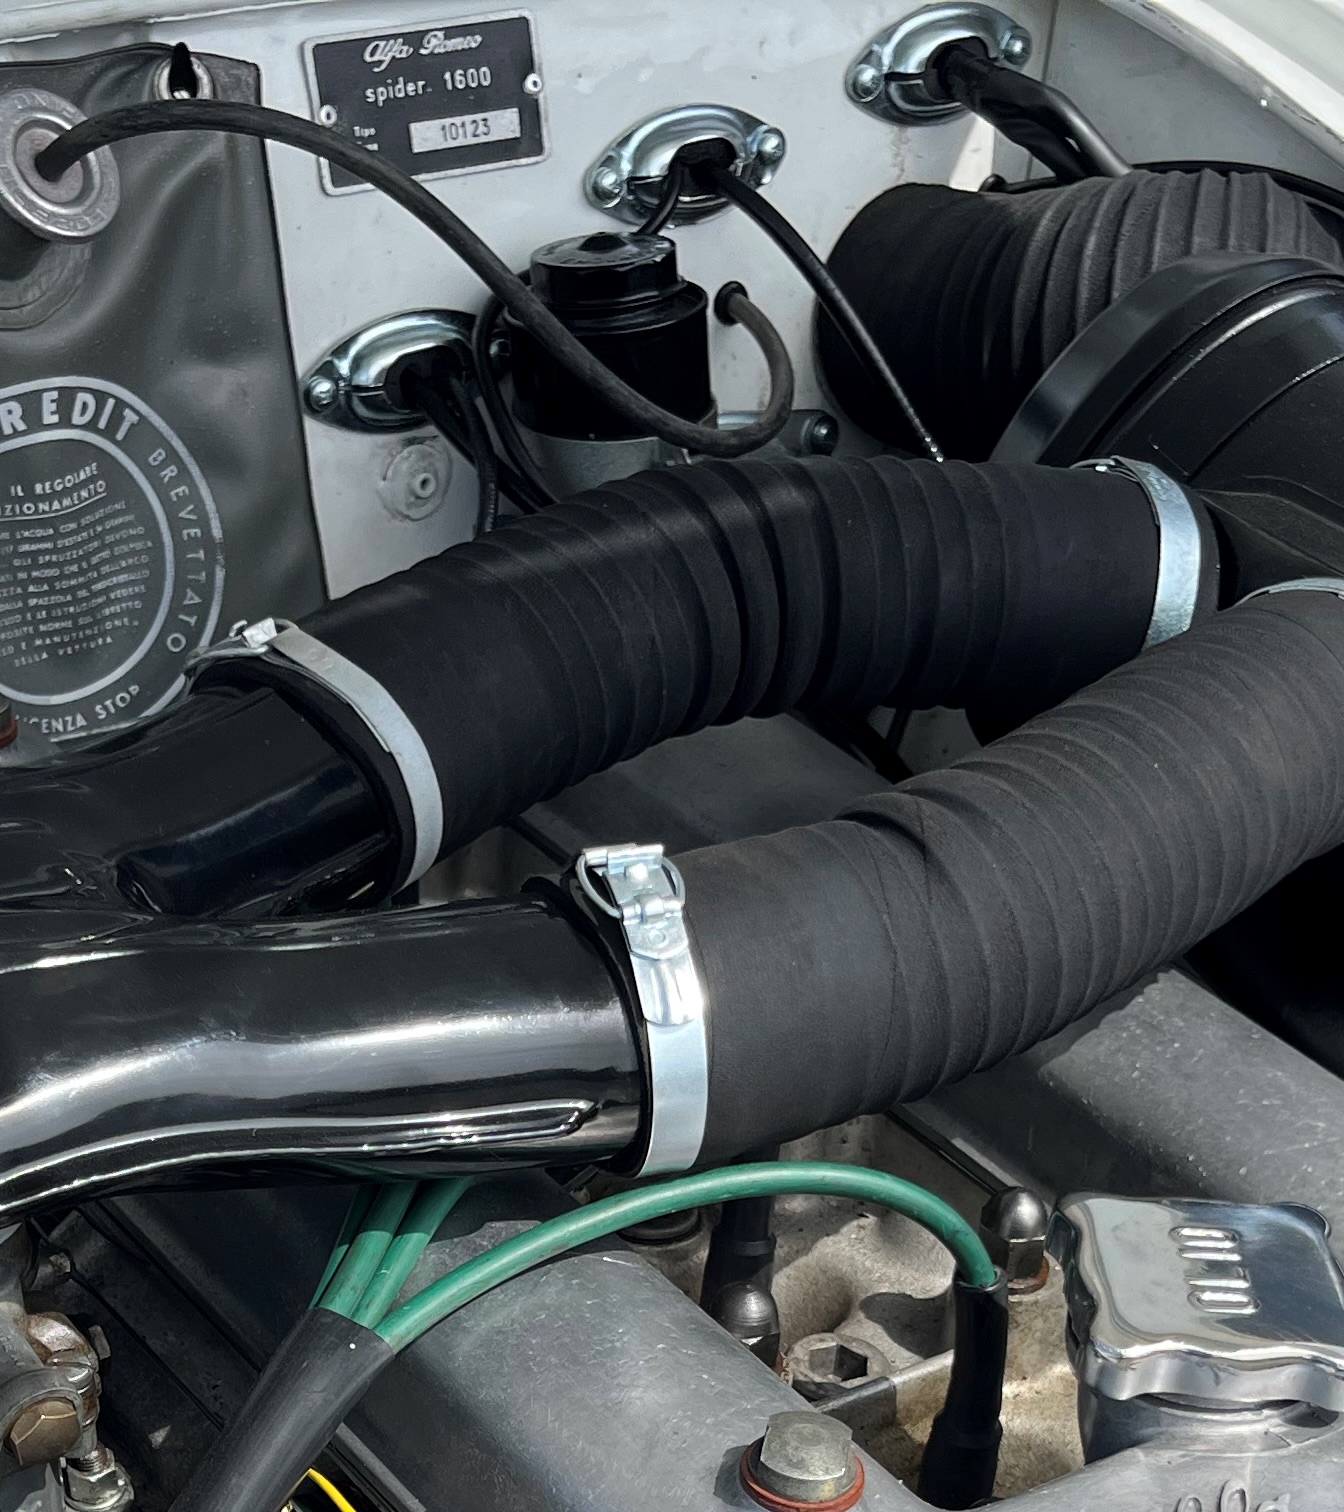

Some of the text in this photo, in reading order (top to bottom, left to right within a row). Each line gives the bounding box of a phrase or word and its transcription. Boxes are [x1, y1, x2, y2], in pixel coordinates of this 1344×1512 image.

[363, 30, 483, 73] Alfa Romeo
[365, 66, 492, 107] spider 1600
[440, 118, 491, 143] 10123
[10, 484, 25, 498] IL
[34, 462, 100, 496] REGOLARE
[146, 448, 206, 655] BREVETTATO
[15, 684, 141, 736] ENZA STOP
